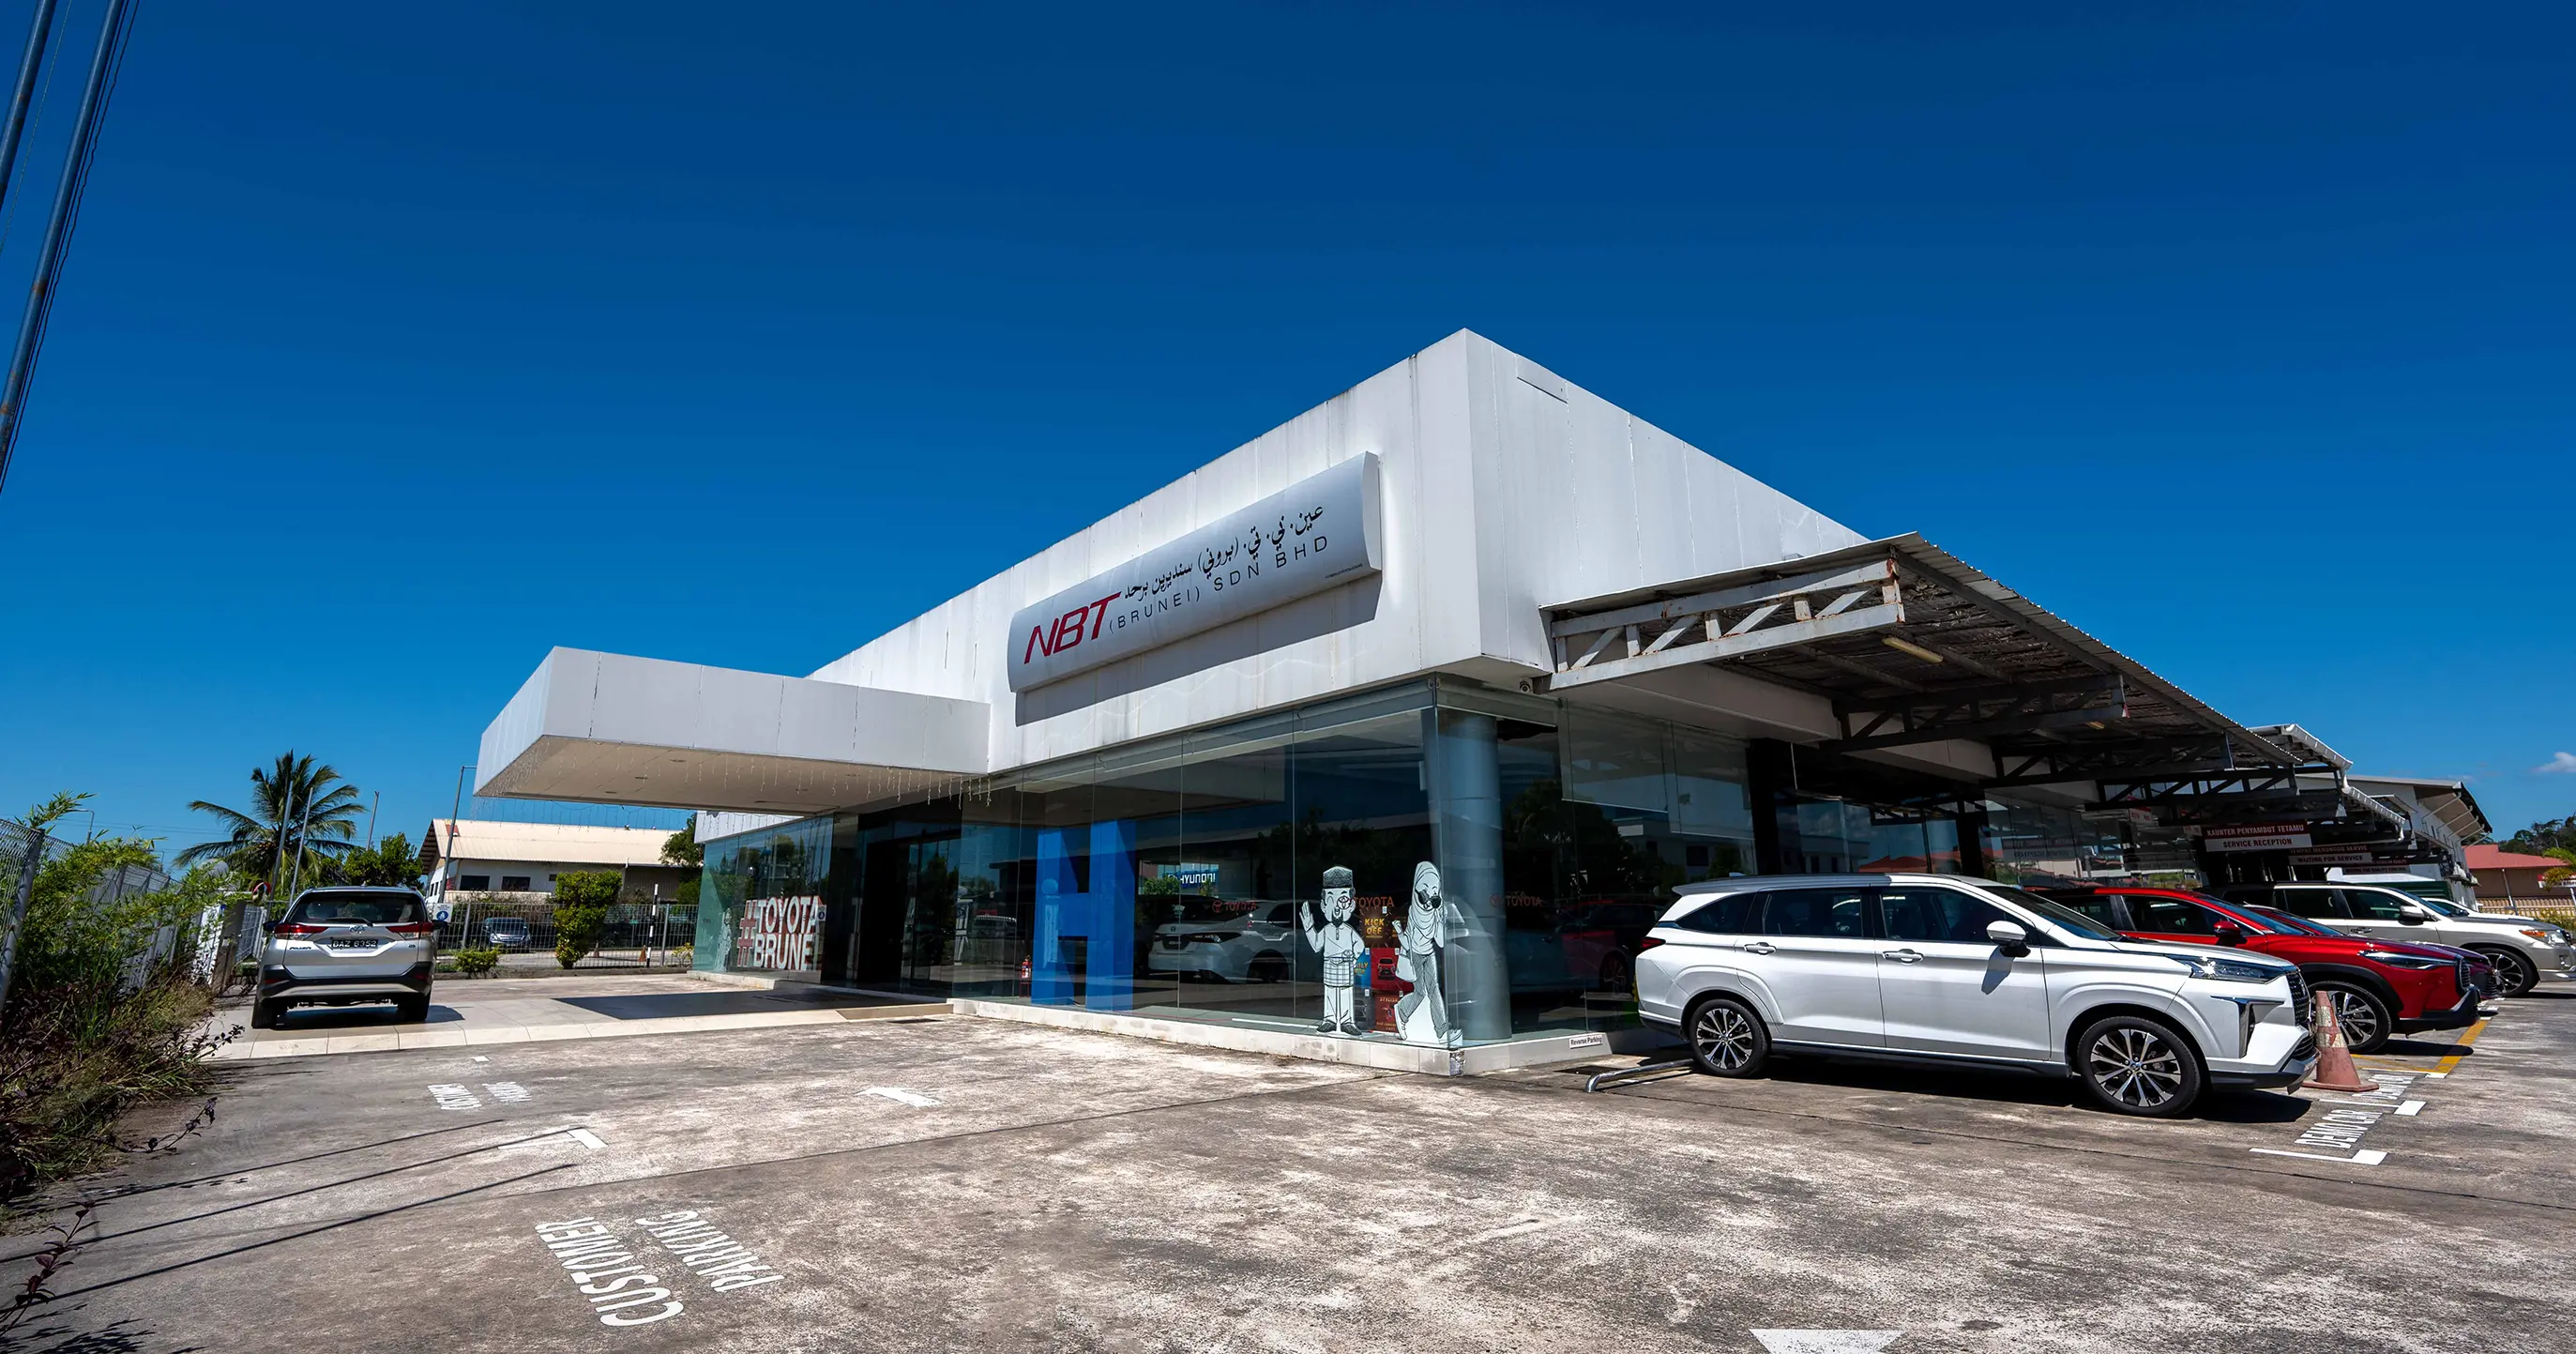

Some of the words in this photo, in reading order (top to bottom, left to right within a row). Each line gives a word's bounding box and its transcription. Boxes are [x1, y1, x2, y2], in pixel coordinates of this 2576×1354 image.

[1023, 591, 1122, 664] NBT
[1109, 586, 1201, 633] (BRUNEI)
[1213, 565, 1261, 592] SDN
[1276, 536, 1328, 569] BHD
[2236, 826, 2276, 835] PENYAMBUT
[2277, 824, 2305, 833] TETAMU
[2223, 839, 2252, 848] SERVICE
[2253, 837, 2293, 846] RECEPTION
[1355, 897, 1395, 907] TOYOTA
[1506, 896, 1542, 907] TOYOTA
[1364, 918, 1385, 927] KICK
[1587, 1036, 1602, 1044] Parking
[2322, 1109, 2383, 1124] CAR
[2294, 1122, 2369, 1149] DEMO
[634, 1209, 785, 1293] PARKING
[534, 1216, 684, 1327] CUSTOMER
